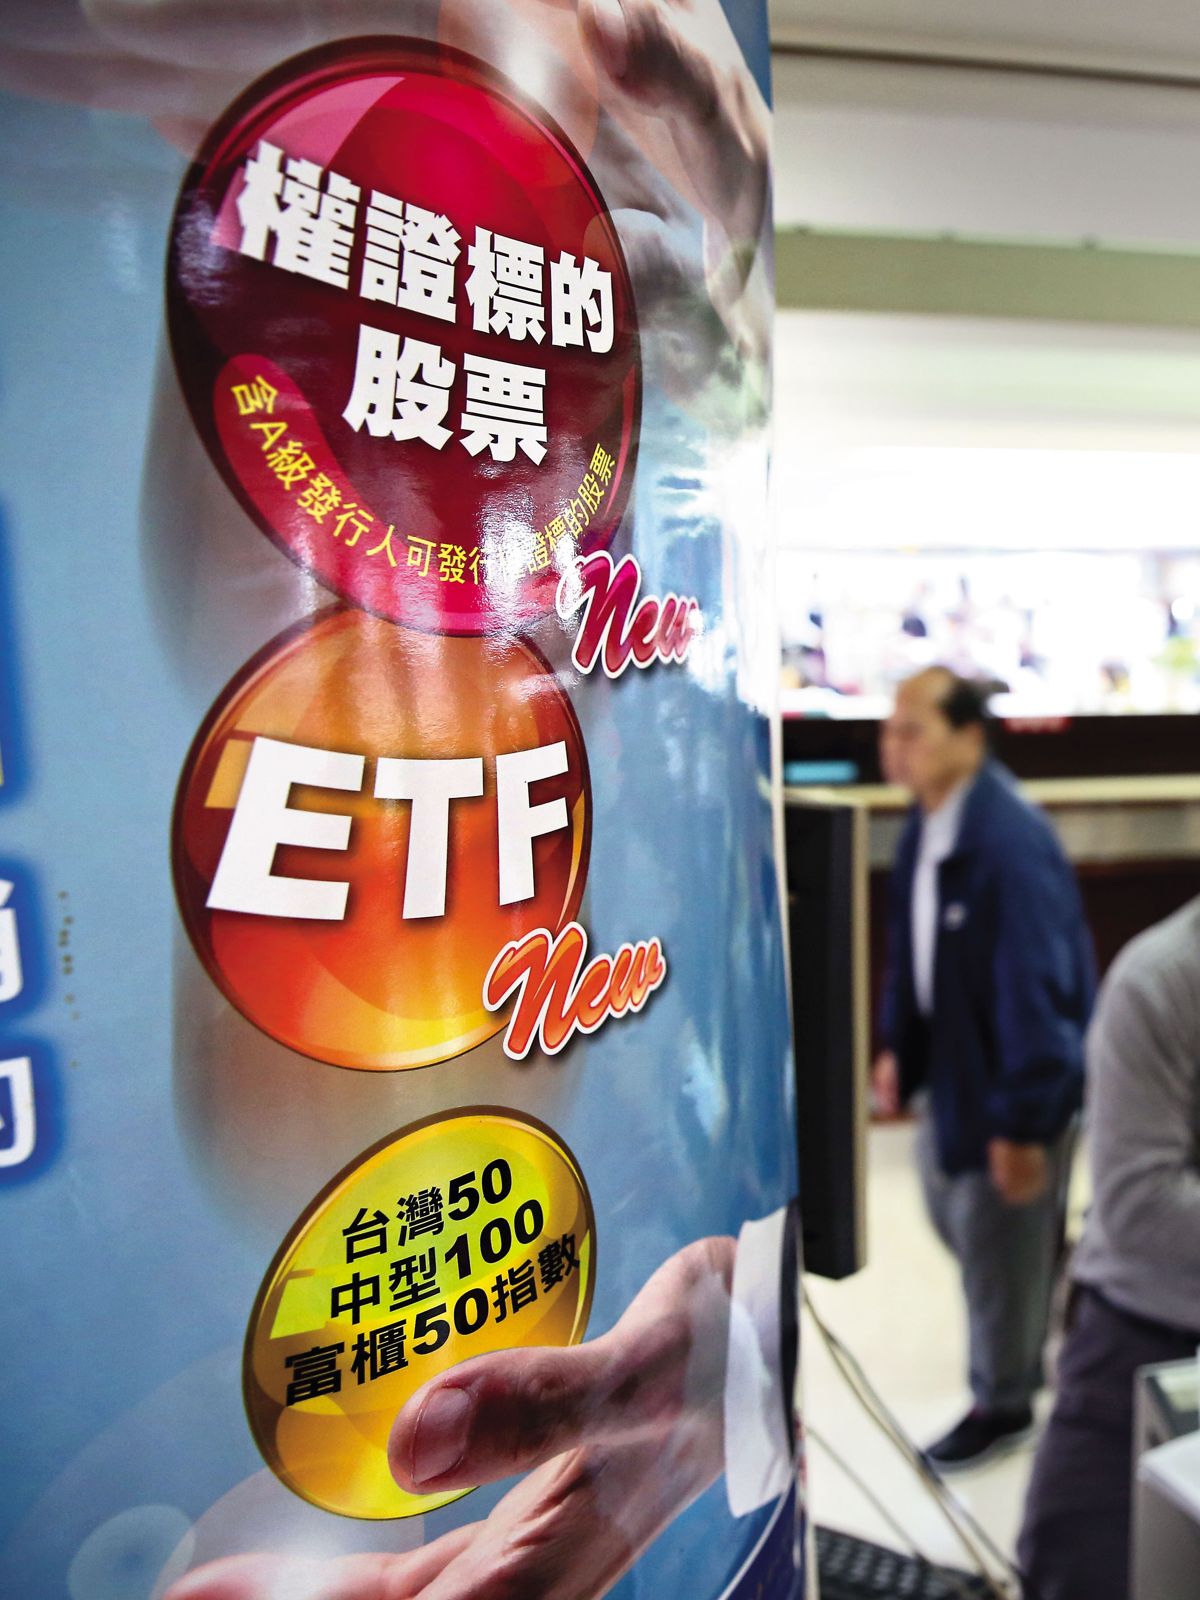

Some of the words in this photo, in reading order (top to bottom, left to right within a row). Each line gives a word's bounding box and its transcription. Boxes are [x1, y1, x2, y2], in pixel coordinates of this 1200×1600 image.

[235, 141, 614, 353] 權證標的
[343, 324, 548, 465] 股票
[231, 375, 616, 585] 含A級發行人可發行證標的股票
[556, 550, 702, 679] New
[206, 737, 569, 920] ETF
[484, 922, 666, 1061] New
[331, 1199, 544, 1325] 中型100
[342, 1158, 512, 1264] 台灣50
[284, 1233, 580, 1406] 富櫃50指數
